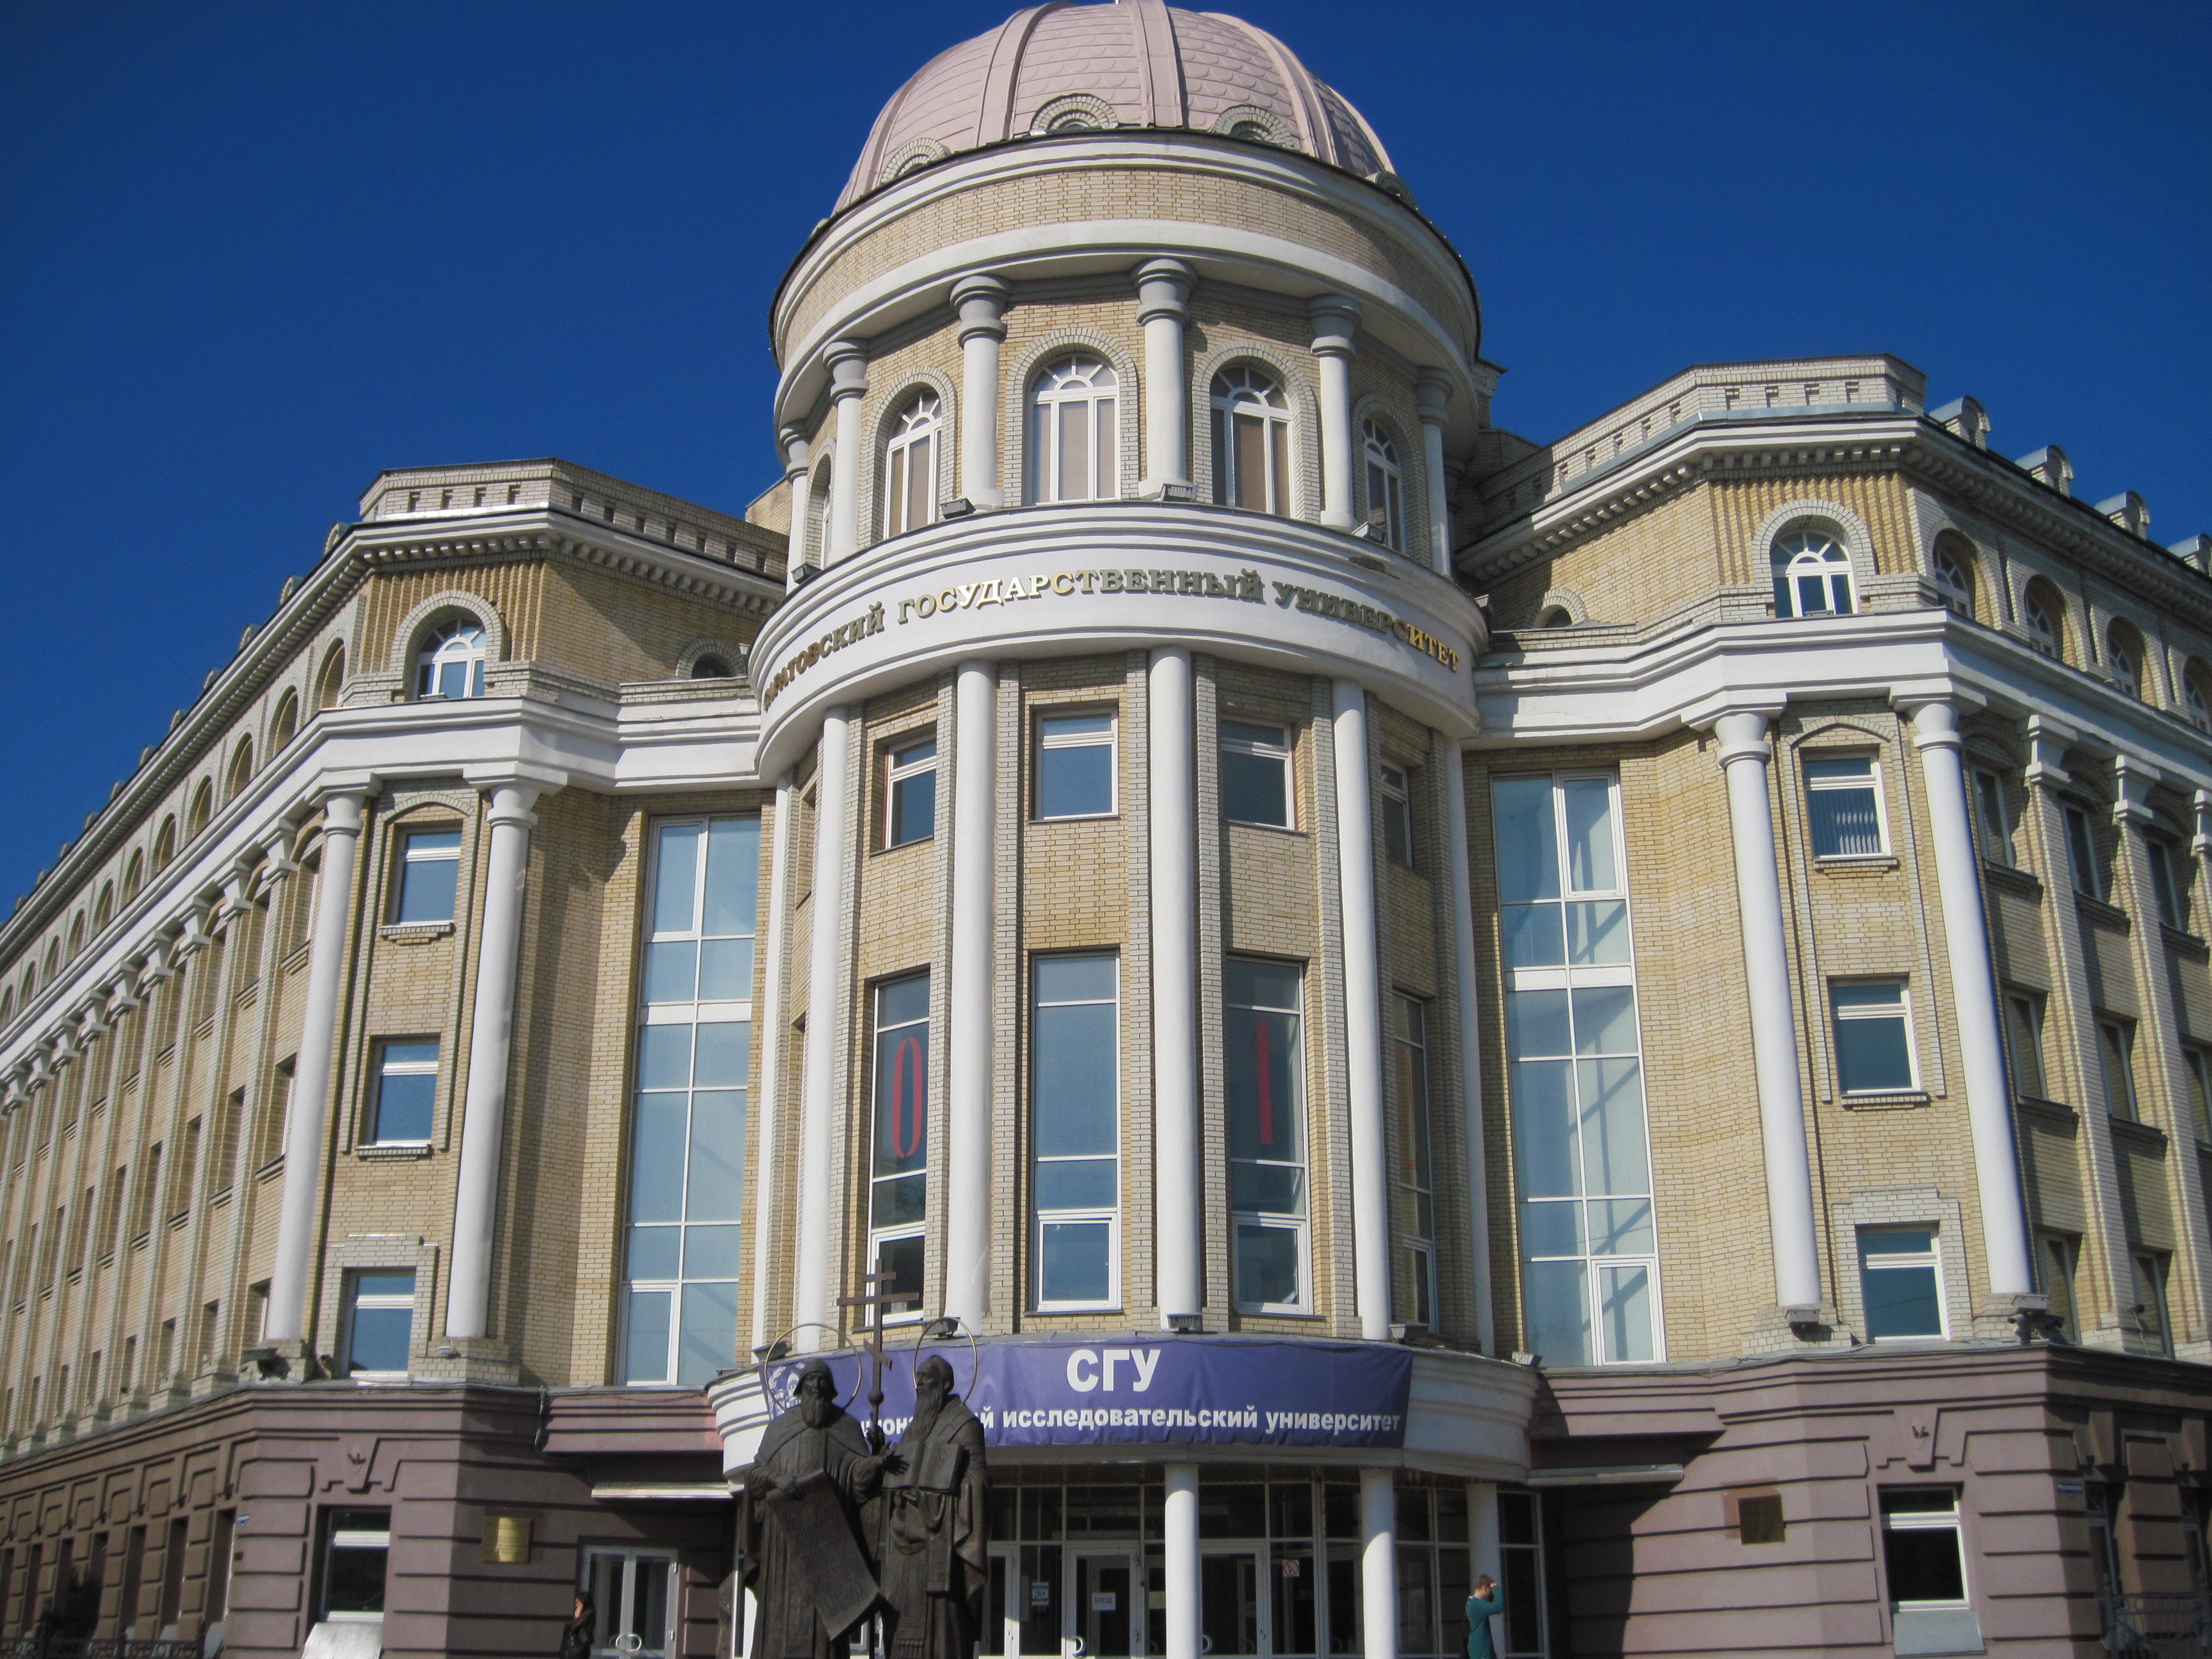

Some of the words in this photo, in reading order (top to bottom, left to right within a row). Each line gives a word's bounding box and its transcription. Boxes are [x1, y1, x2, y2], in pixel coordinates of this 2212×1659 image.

[897, 568, 1265, 624] ГОСУДАРСТВЕННЫЙ
[1272, 581, 1459, 673] УНИВЕРСИТЕТ
[1067, 1349, 1161, 1392] СГУ
[1003, 1405, 1258, 1431] исследовательский
[1265, 1411, 1400, 1435] университет
